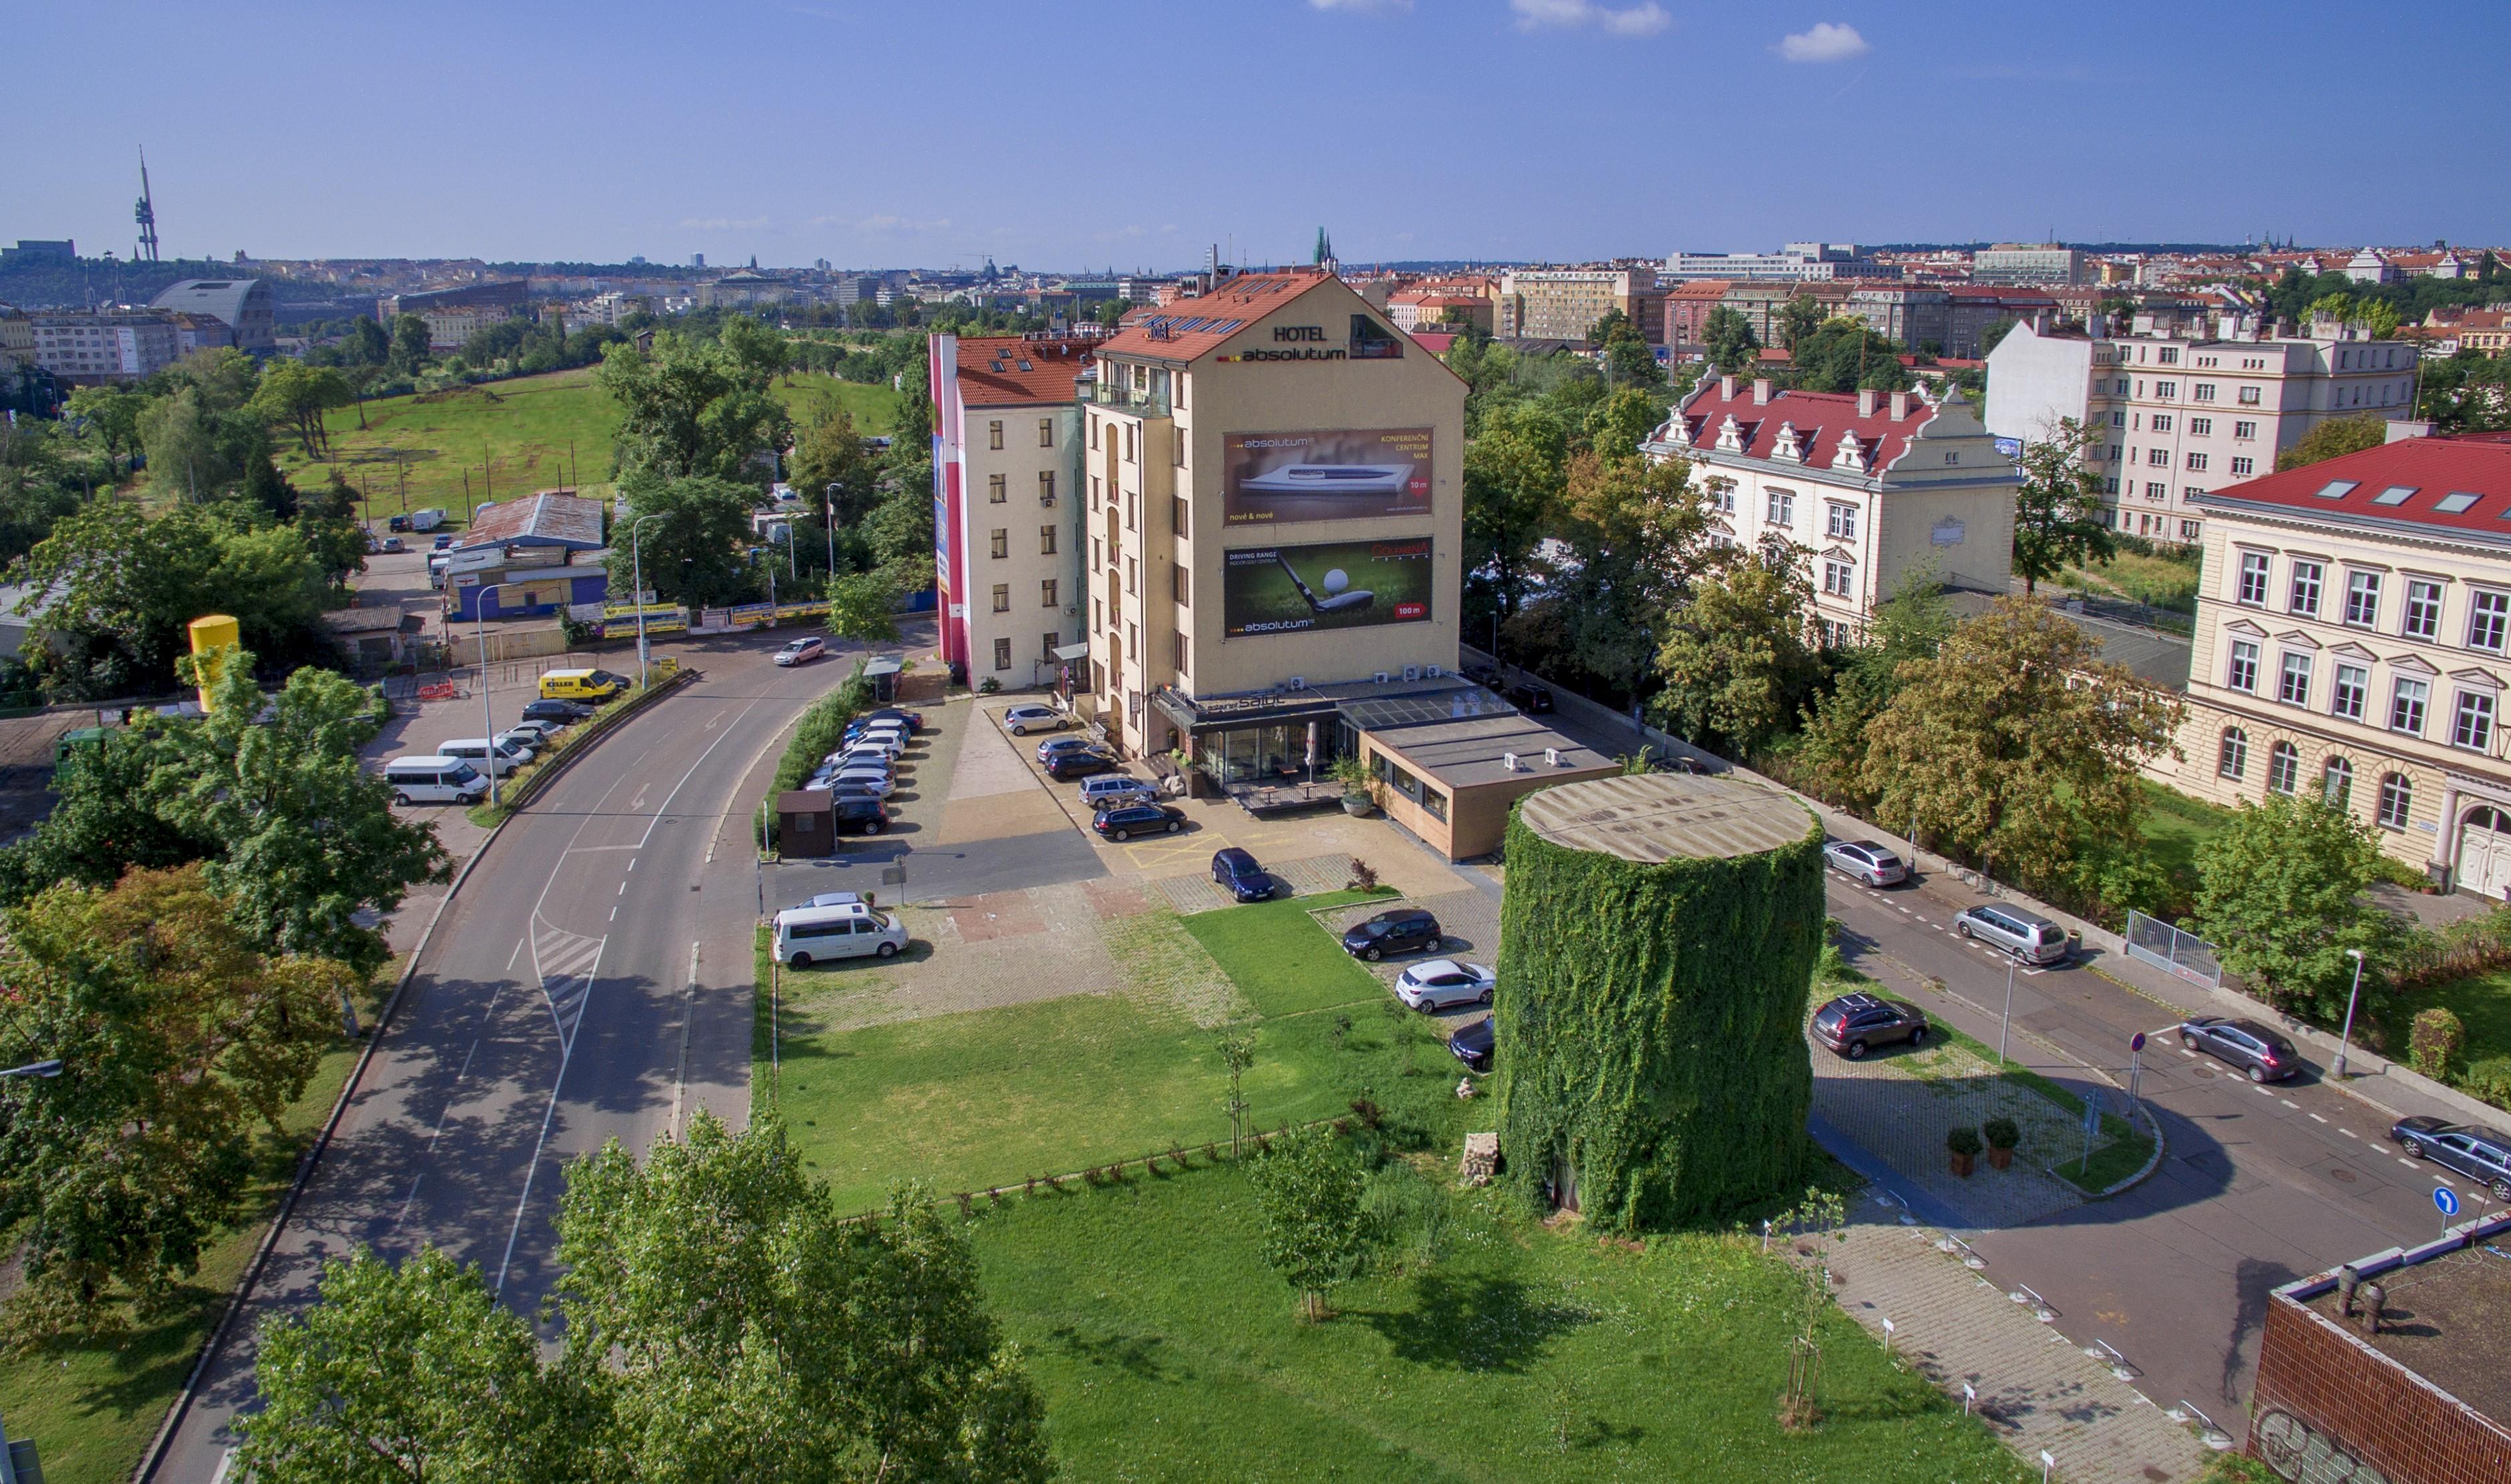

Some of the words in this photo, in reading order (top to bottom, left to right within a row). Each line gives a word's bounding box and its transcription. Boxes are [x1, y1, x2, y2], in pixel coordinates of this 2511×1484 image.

[1151, 321, 1168, 340] hotel
[1274, 327, 1327, 342] HOTEL
[1242, 347, 1346, 361] absolutum
[1244, 438, 1308, 448] absolutum
[1381, 434, 1428, 442] KONFERENČNÍ
[1230, 513, 1247, 521] nové
[1256, 511, 1273, 519] nové
[1245, 620, 1308, 632] absolutum
[1208, 703, 1238, 711] restaurant
